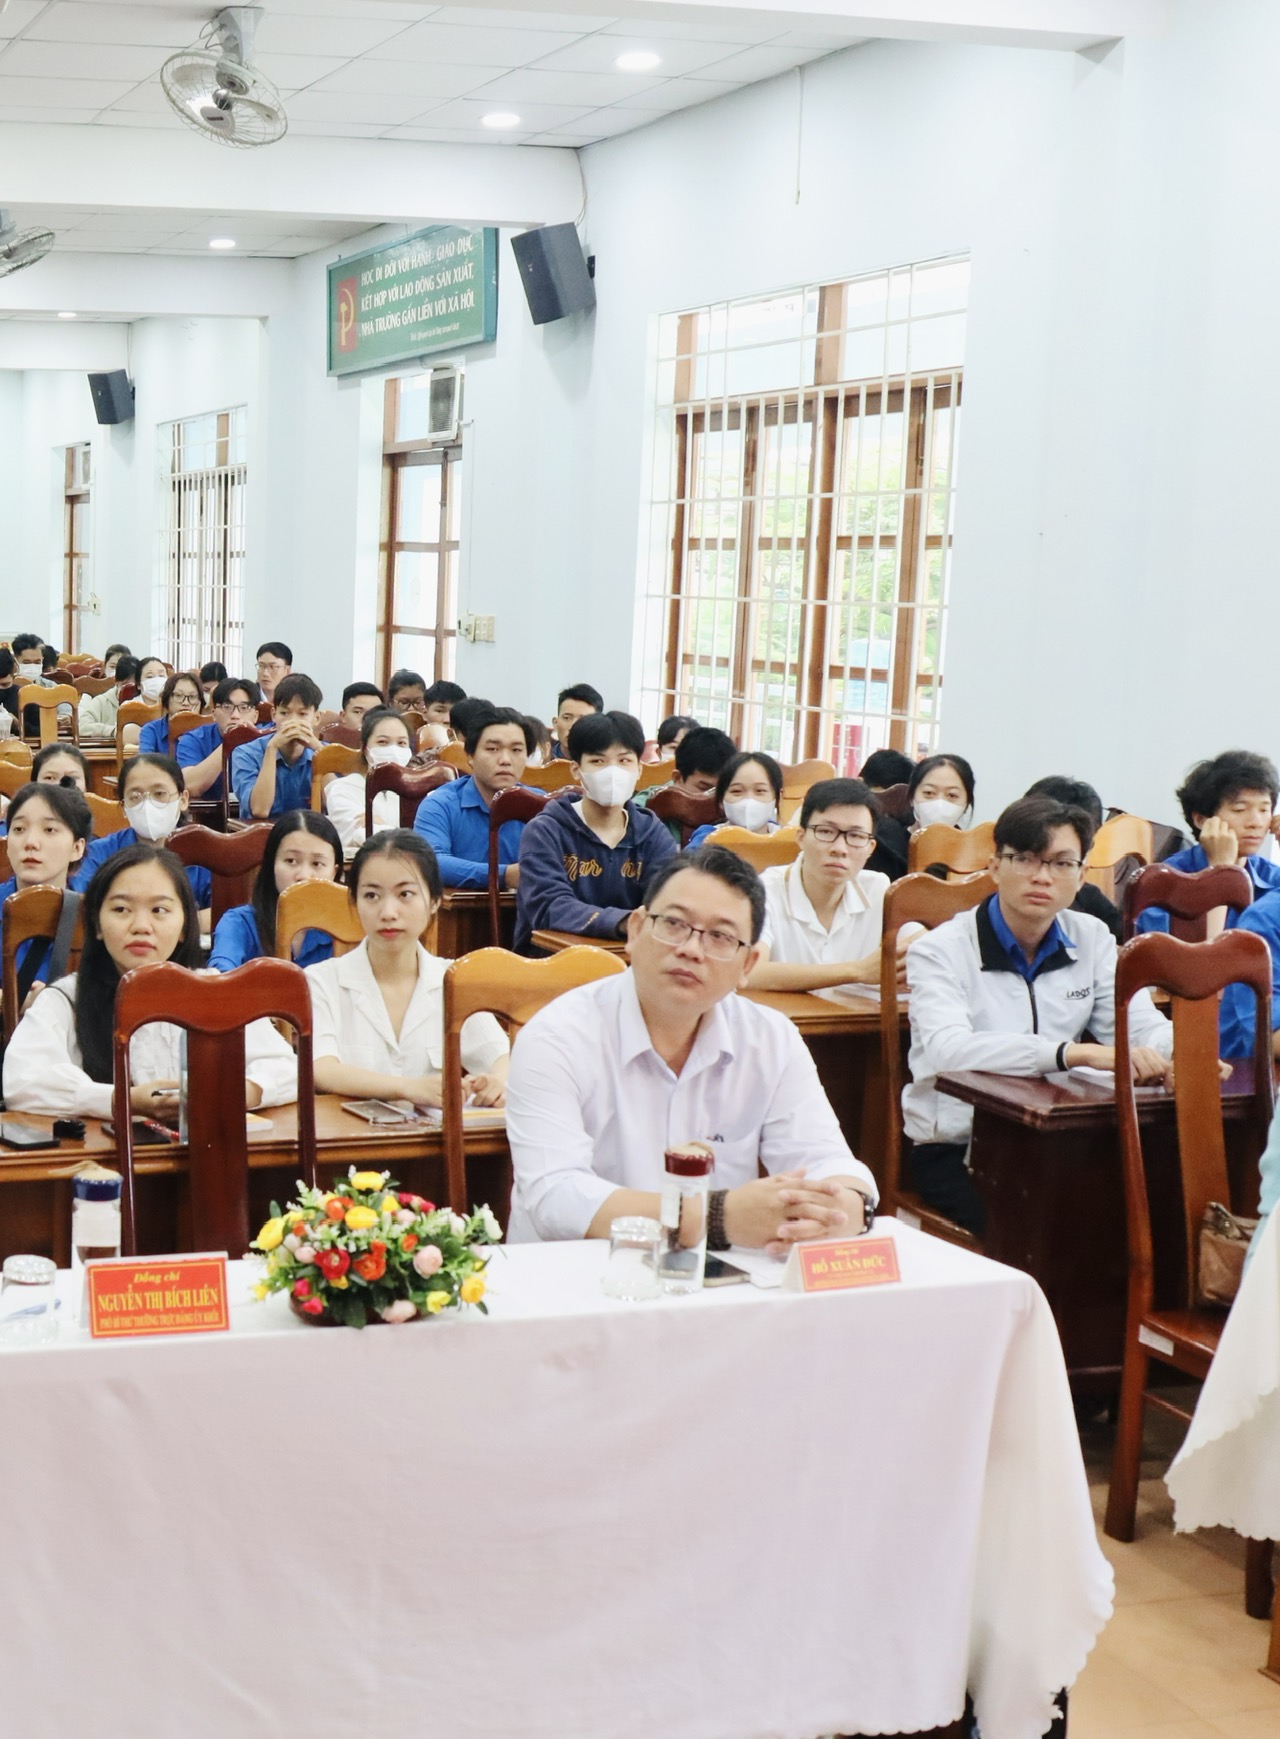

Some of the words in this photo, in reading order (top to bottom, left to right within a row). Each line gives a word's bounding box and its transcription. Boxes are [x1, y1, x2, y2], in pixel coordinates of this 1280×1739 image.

[400, 281, 414, 299] LAO
[134, 1272, 161, 1285] Đồng
[164, 1271, 180, 1282] chí
[98, 1284, 143, 1312] NGUYỄN
[144, 1289, 164, 1312] THỊ
[165, 1285, 191, 1308] BÍCH
[193, 1283, 219, 1306] LIÊN
